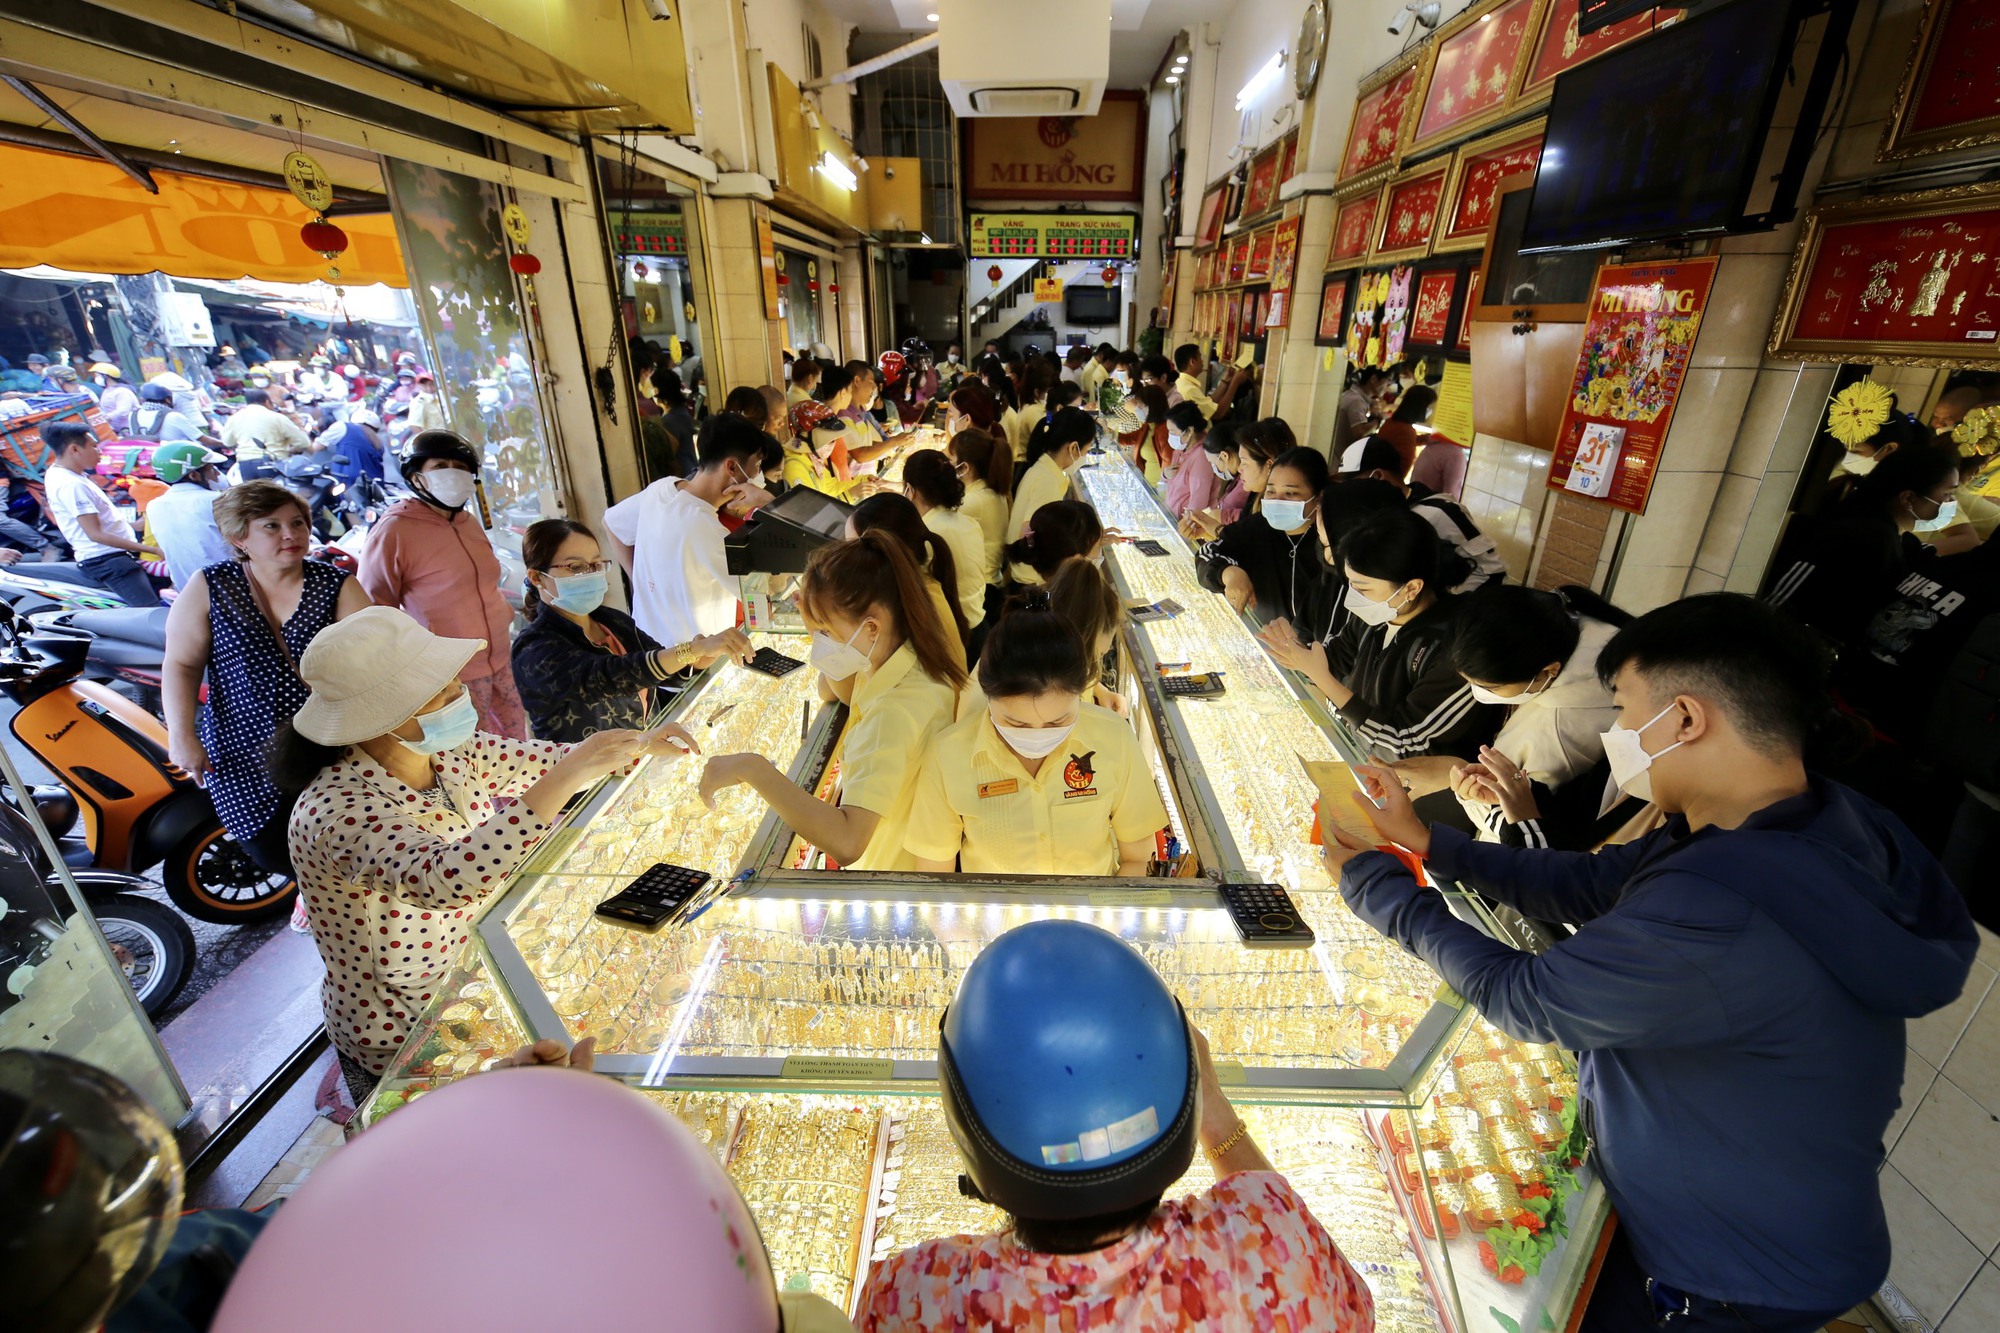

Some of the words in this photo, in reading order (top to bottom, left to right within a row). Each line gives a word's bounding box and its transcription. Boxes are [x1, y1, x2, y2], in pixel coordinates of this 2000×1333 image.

[990, 162, 1029, 182] MI
[1034, 152, 1117, 184] HỒNG
[1002, 218, 1024, 228] VÀNG
[1100, 219, 1121, 228] VÀNG
[1597, 291, 1625, 313] MI
[1626, 283, 1696, 313] HỒNG
[1582, 436, 1609, 466] 31
[1580, 476, 1591, 489] 10
[1069, 778, 1090, 788] MH
